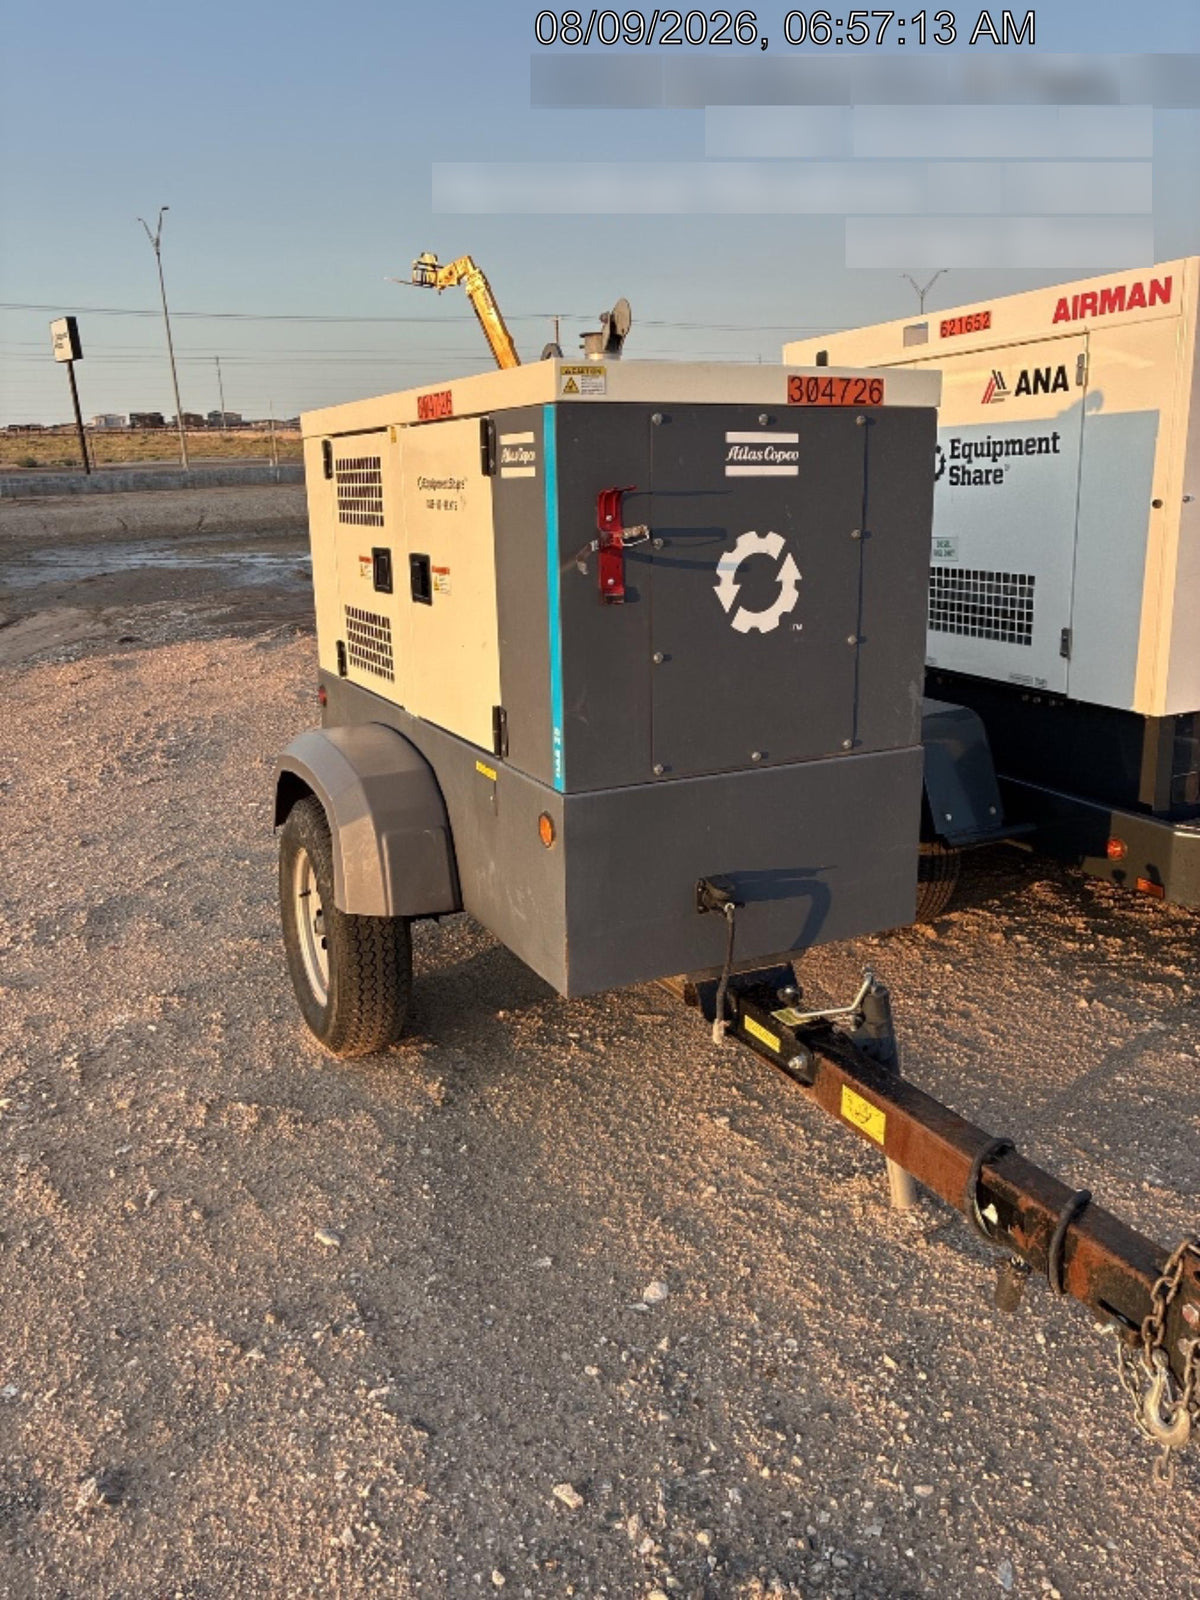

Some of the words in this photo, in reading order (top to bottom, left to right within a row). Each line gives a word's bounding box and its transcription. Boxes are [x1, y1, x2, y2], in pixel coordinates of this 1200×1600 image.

[1052, 276, 1173, 324] AIRMAN
[940, 311, 992, 338] 621652
[789, 376, 883, 405] 304726
[1014, 365, 1070, 397] ANA
[725, 446, 764, 461] Atlas
[763, 446, 799, 463] Copco
[949, 431, 1061, 464] Equipment
[949, 465, 1004, 486] Share
